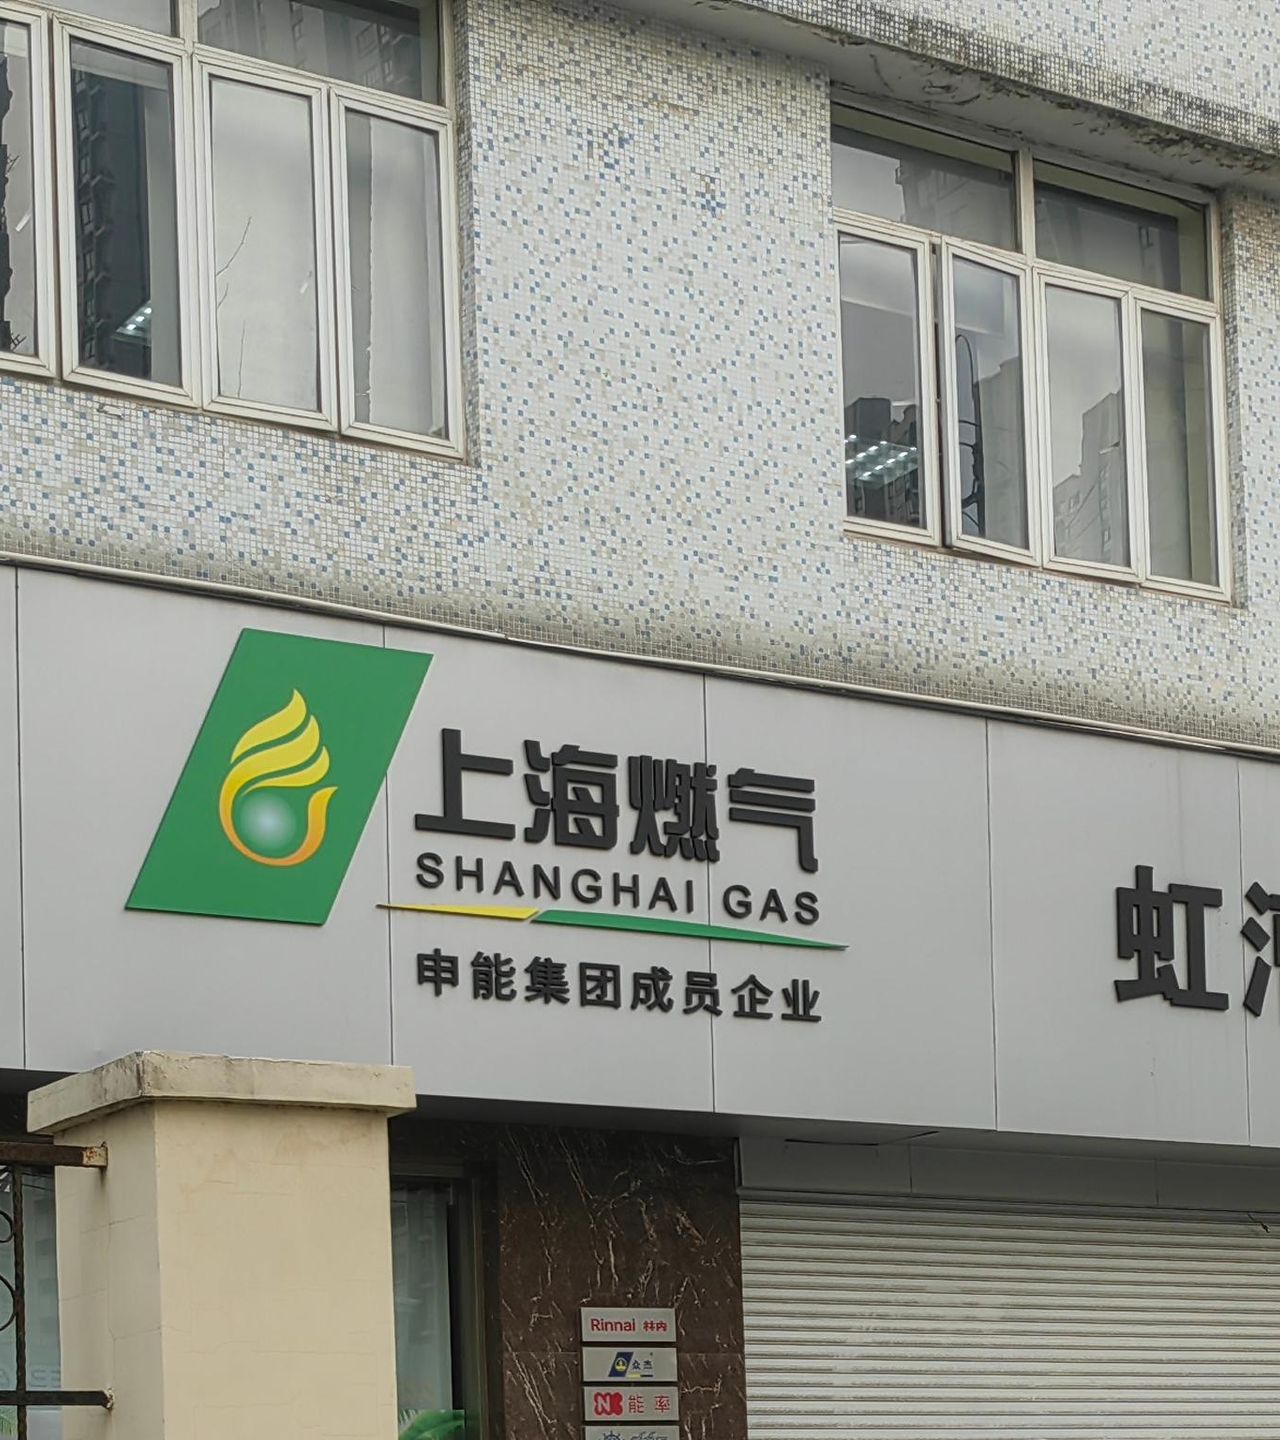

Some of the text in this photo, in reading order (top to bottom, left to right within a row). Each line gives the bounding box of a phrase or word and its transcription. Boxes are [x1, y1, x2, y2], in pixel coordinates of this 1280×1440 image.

[415, 728, 818, 873] 上海燃气
[416, 852, 820, 926] SHANGHAI GAS
[416, 948, 822, 1024] 申能集团成员企业
[590, 1318, 667, 1332] Rinnai 林内
[628, 1394, 670, 1414] 能率
